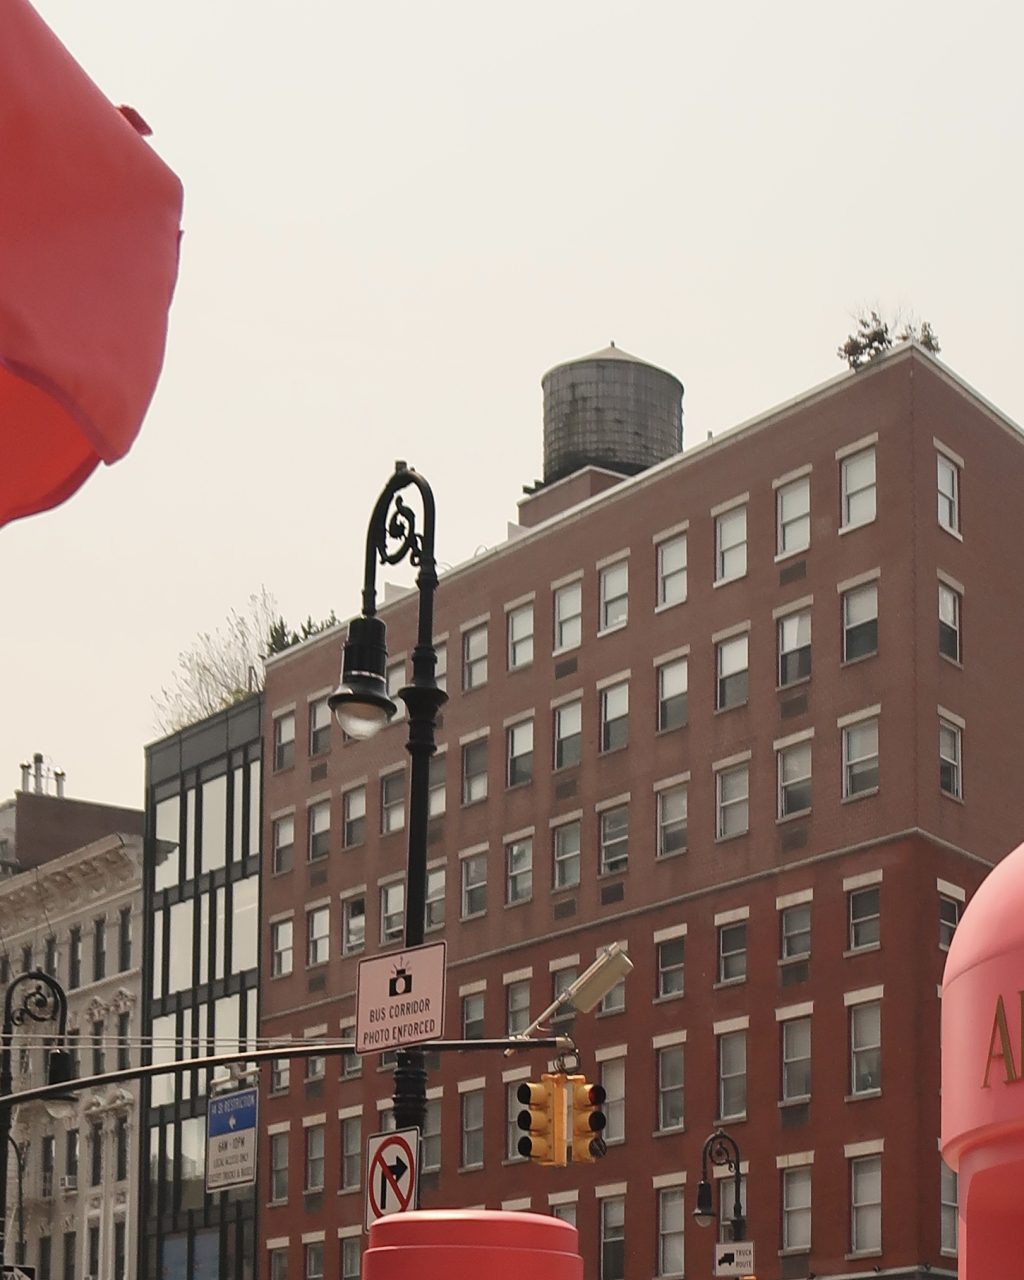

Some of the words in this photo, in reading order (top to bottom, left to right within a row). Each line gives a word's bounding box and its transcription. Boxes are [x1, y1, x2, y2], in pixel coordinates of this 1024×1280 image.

[369, 1007, 386, 1023] BUS
[389, 998, 431, 1019] CORRIDOR
[363, 1028, 390, 1045] PHOTO
[392, 1018, 435, 1040] ENFORCED
[736, 1249, 752, 1257] TRUCK
